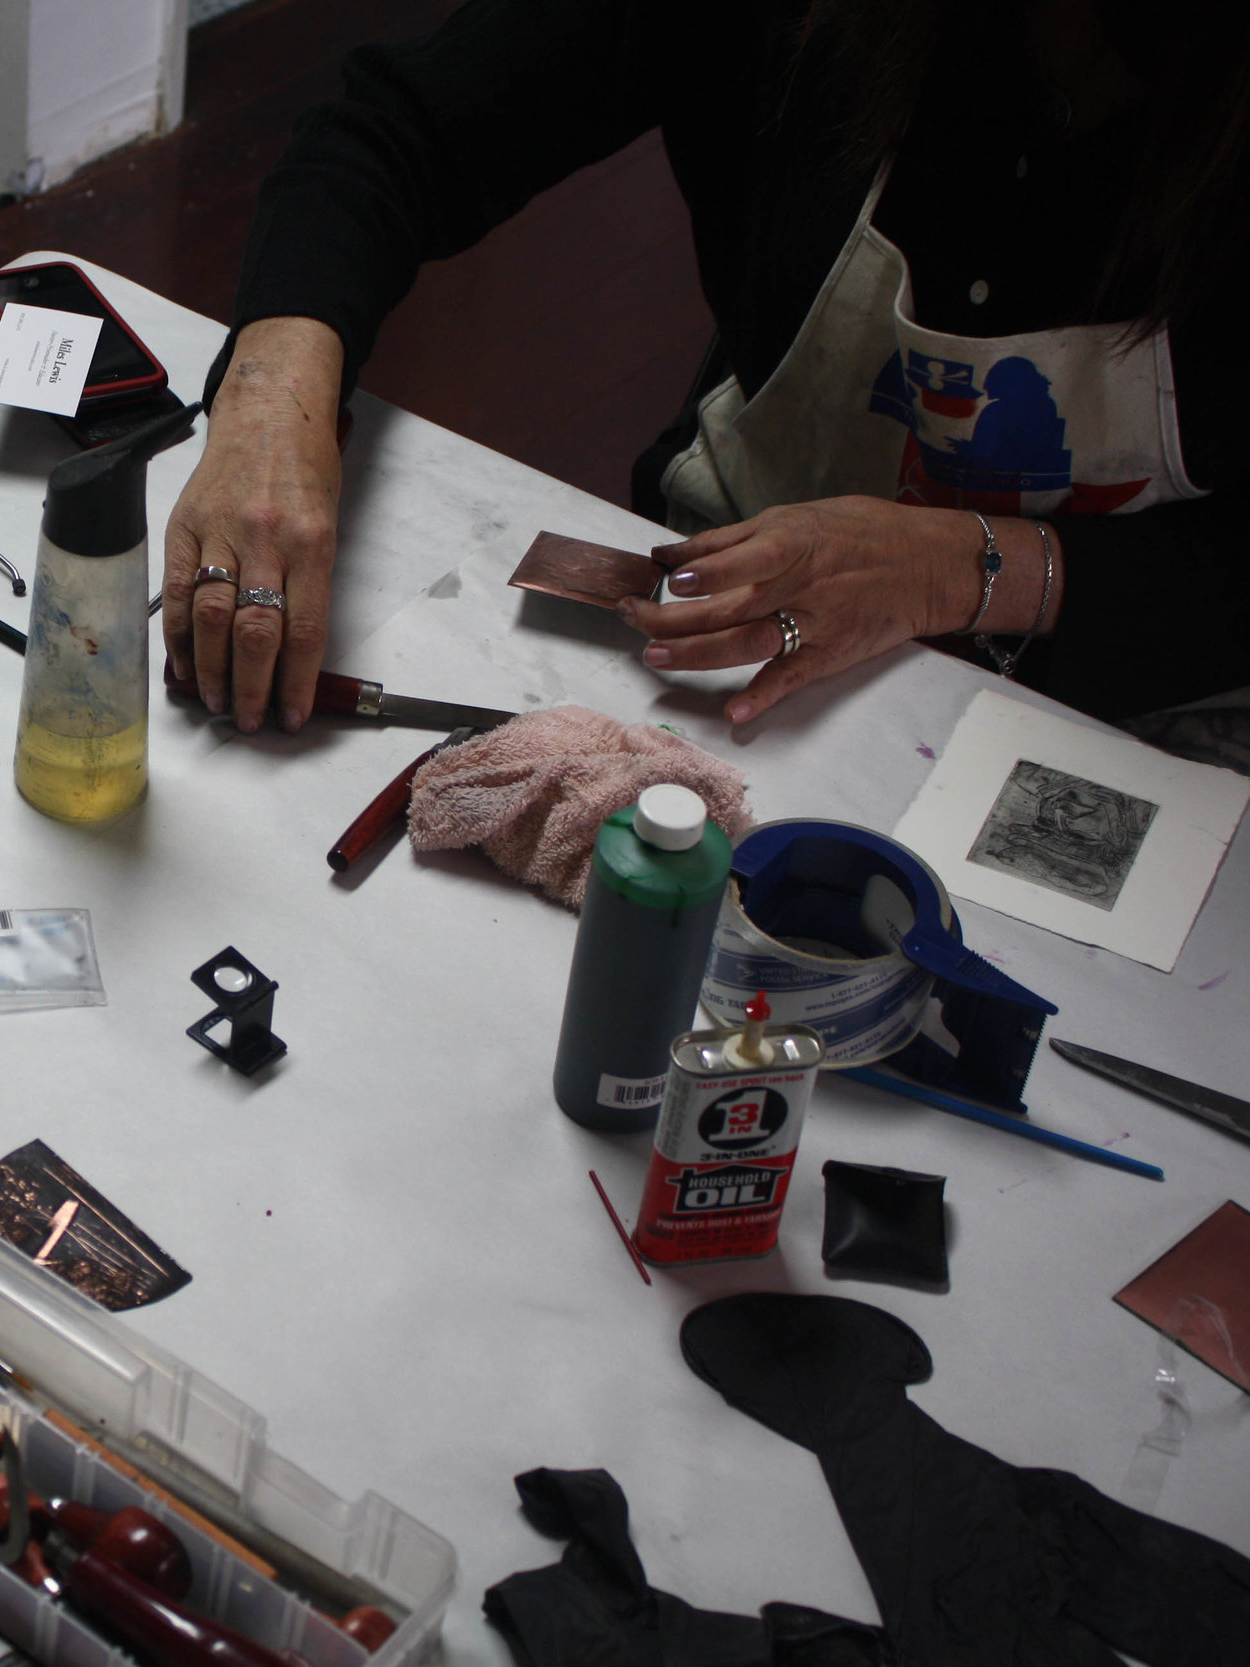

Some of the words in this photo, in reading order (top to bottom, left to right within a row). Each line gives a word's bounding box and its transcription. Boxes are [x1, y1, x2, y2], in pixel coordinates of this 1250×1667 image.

[56, 337, 74, 359] Miles
[48, 360, 66, 385] Lewis
[728, 1103, 760, 1126] 3
[729, 1125, 752, 1135] IN
[688, 1171, 771, 1188] HOUSEHOLD
[684, 1184, 767, 1208] OIL
[656, 1218, 705, 1230] PREVENTS
